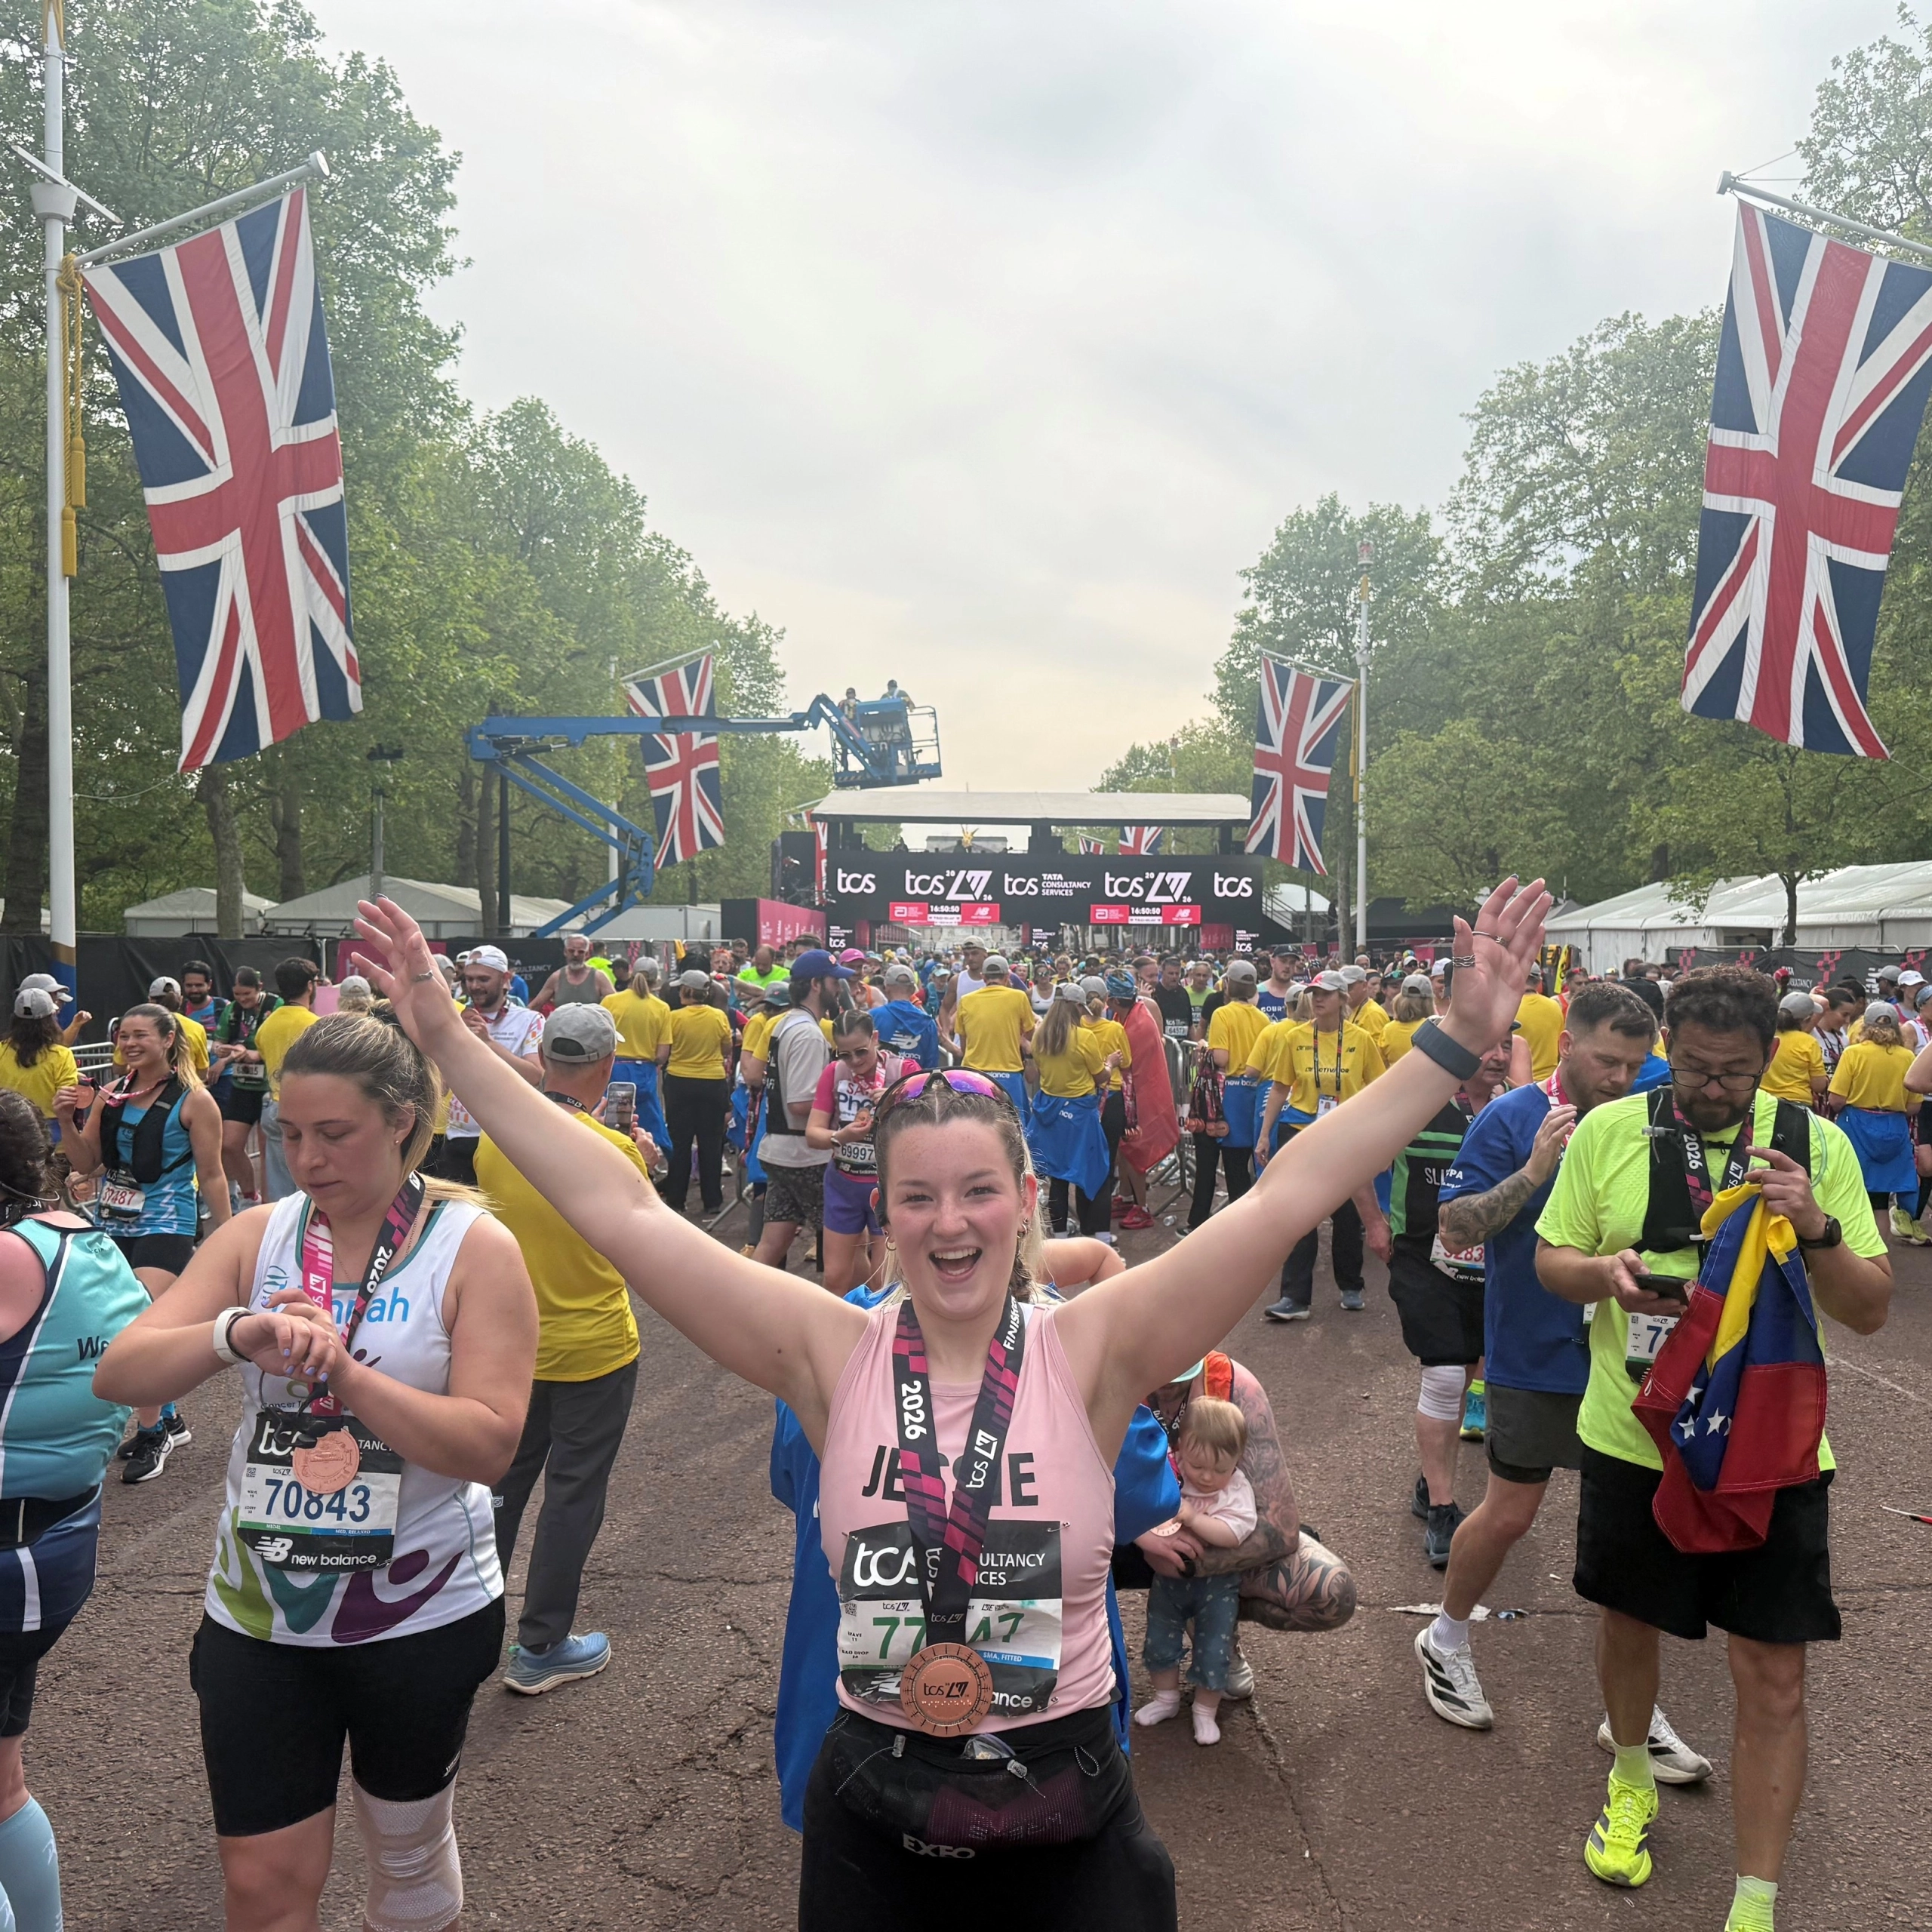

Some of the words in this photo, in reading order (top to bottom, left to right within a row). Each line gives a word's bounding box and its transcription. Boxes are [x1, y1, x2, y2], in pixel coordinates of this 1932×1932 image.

[838, 868, 875, 894] tcs
[906, 869, 944, 895] tcs
[1004, 873, 1038, 896] tcs
[1105, 872, 1143, 897] tcs
[1214, 872, 1253, 897] tcs
[829, 938, 846, 947] tcs
[1235, 942, 1252, 952] tcs
[841, 1145, 874, 1161] 69997
[1683, 1134, 1703, 1169] 2026
[901, 1380, 927, 1440] 2026
[258, 1420, 295, 1456] tc
[861, 1444, 1038, 1506] JEE
[965, 1461, 989, 1488] tcs
[265, 1478, 371, 1523] 70843
[291, 1554, 318, 1565] new
[320, 1554, 377, 1566] balance
[979, 1553, 1045, 1567] ULTANCY
[975, 1571, 1007, 1586] ICES
[882, 1602, 895, 1611] tcs
[931, 1613, 946, 1623] tcs
[873, 1612, 1025, 1660] 7747
[983, 1651, 999, 1660] SMA,
[924, 1683, 945, 1697] tcs
[991, 1691, 1033, 1708] ance
